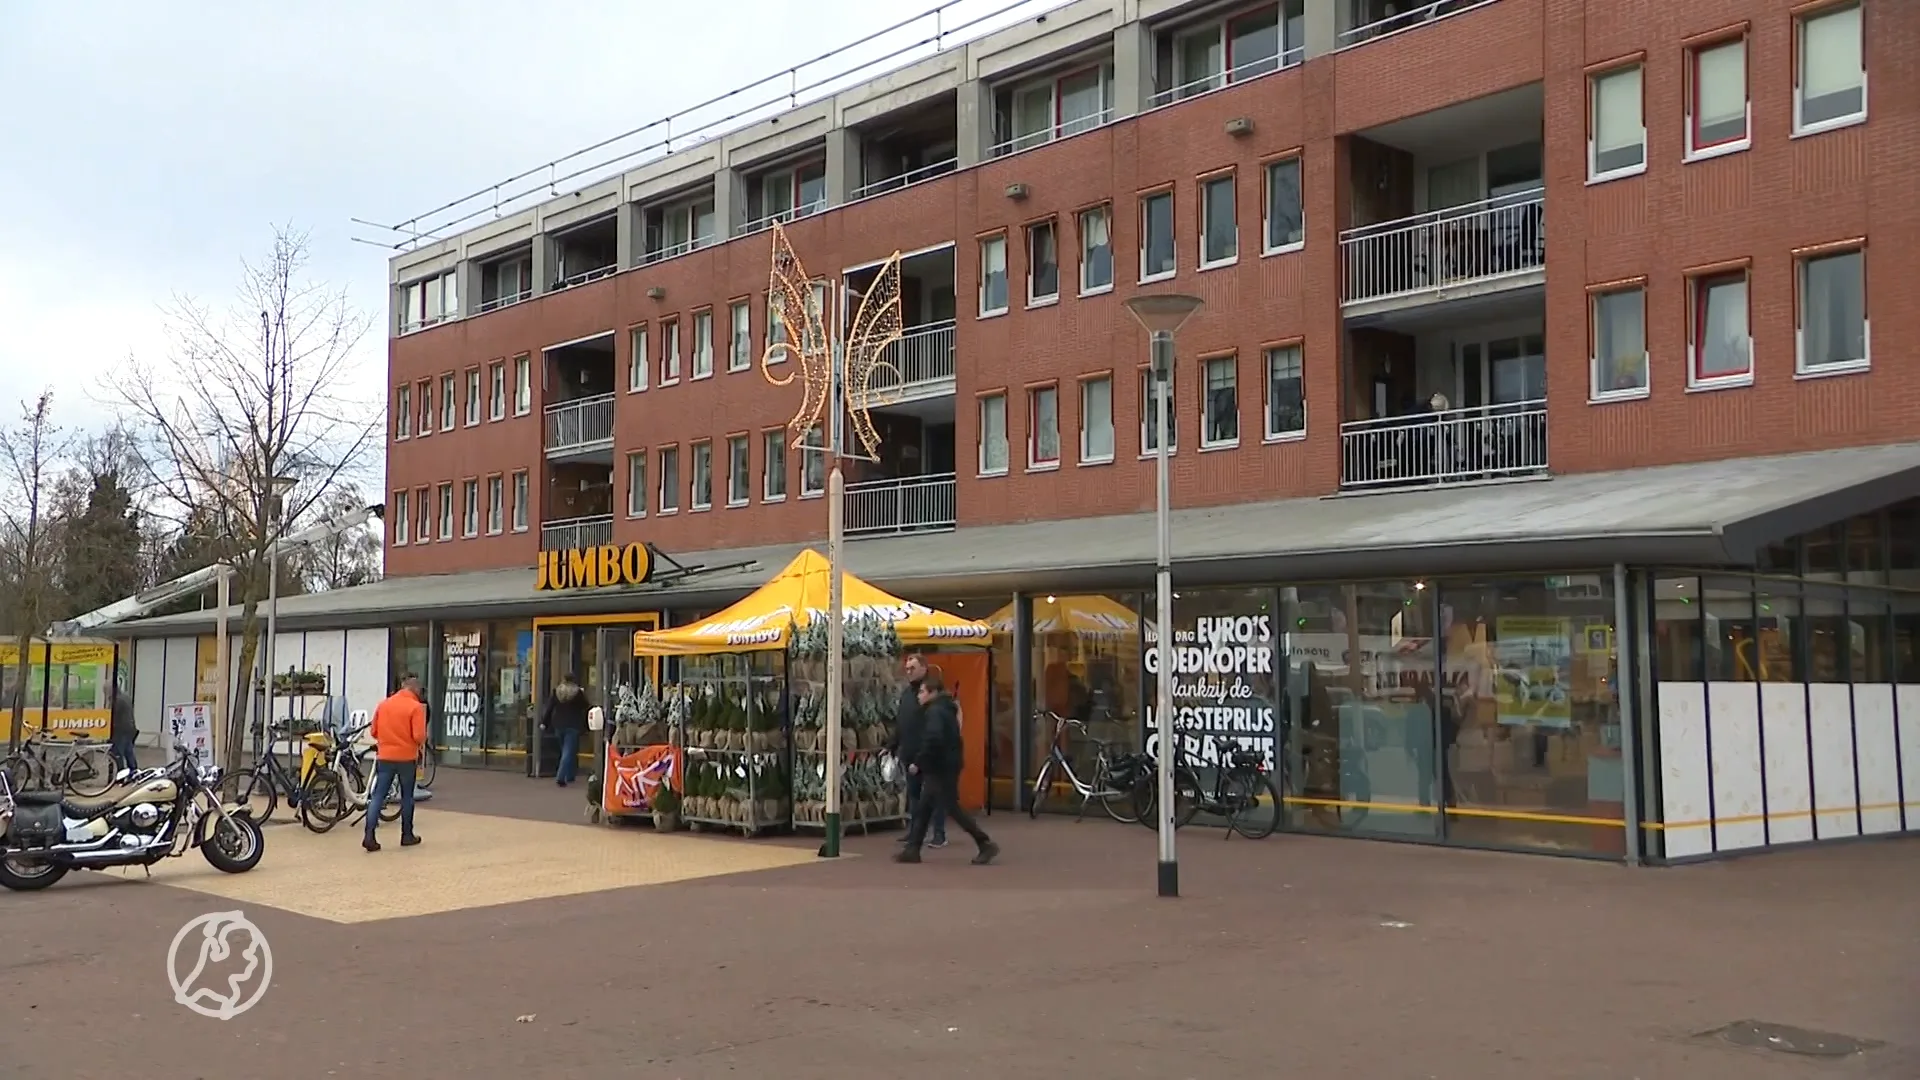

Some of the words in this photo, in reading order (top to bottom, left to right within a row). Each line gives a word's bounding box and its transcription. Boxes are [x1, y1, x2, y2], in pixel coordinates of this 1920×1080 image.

[534, 542, 649, 590] JUMBO
[727, 628, 781, 645] JUMBO
[928, 625, 989, 639] JUMBO
[1197, 616, 1270, 643] EURO'S
[448, 656, 476, 678] PRIJS
[1229, 676, 1253, 698] de
[444, 692, 479, 713] ALTIJD
[53, 717, 107, 729] JUMBO
[446, 715, 475, 737] LAAG
[1146, 705, 1274, 732] LGSTEPRIJS
